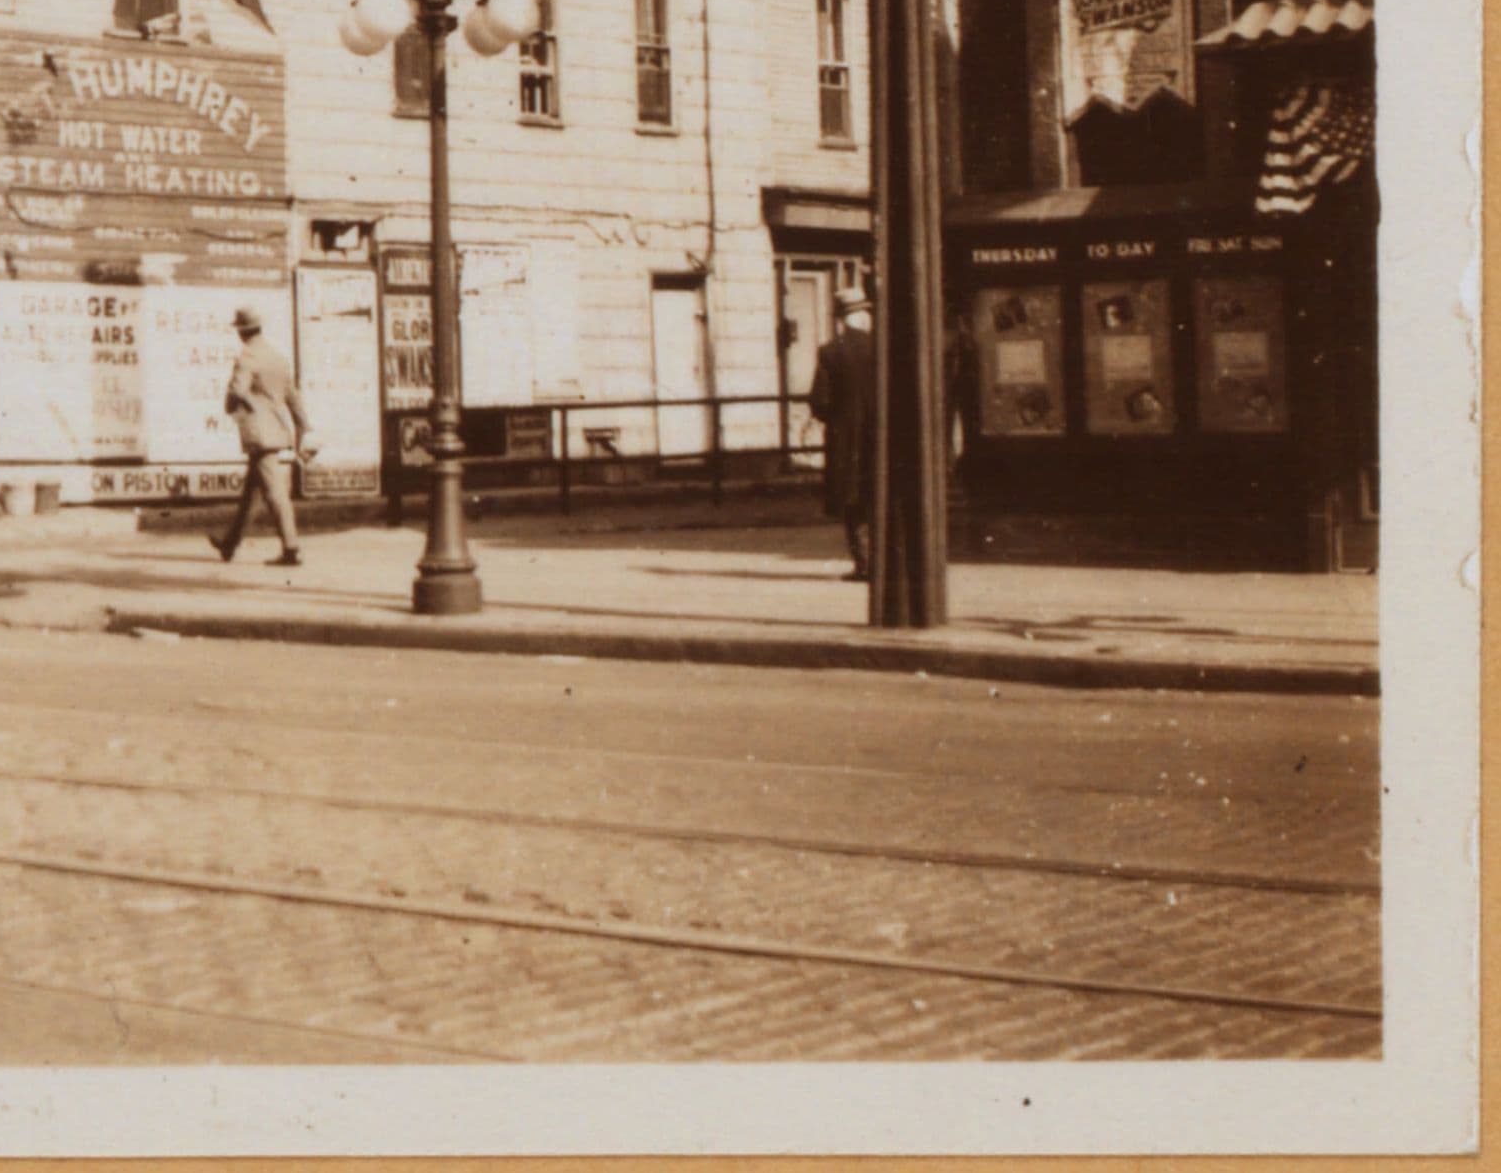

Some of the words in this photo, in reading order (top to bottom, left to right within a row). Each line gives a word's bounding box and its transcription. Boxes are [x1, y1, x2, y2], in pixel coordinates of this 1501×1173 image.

[66, 57, 272, 154] HUMPHREY
[58, 120, 107, 149] HOT
[120, 124, 203, 155] WATER
[971, 246, 1059, 264] THURSDAY
[1087, 243, 1109, 259] TO
[1115, 240, 1156, 257] DAY
[20, 294, 117, 318] GARAGE
[392, 320, 431, 342] GLOR
[123, 472, 190, 494] PISTON
[198, 472, 245, 493] RING
